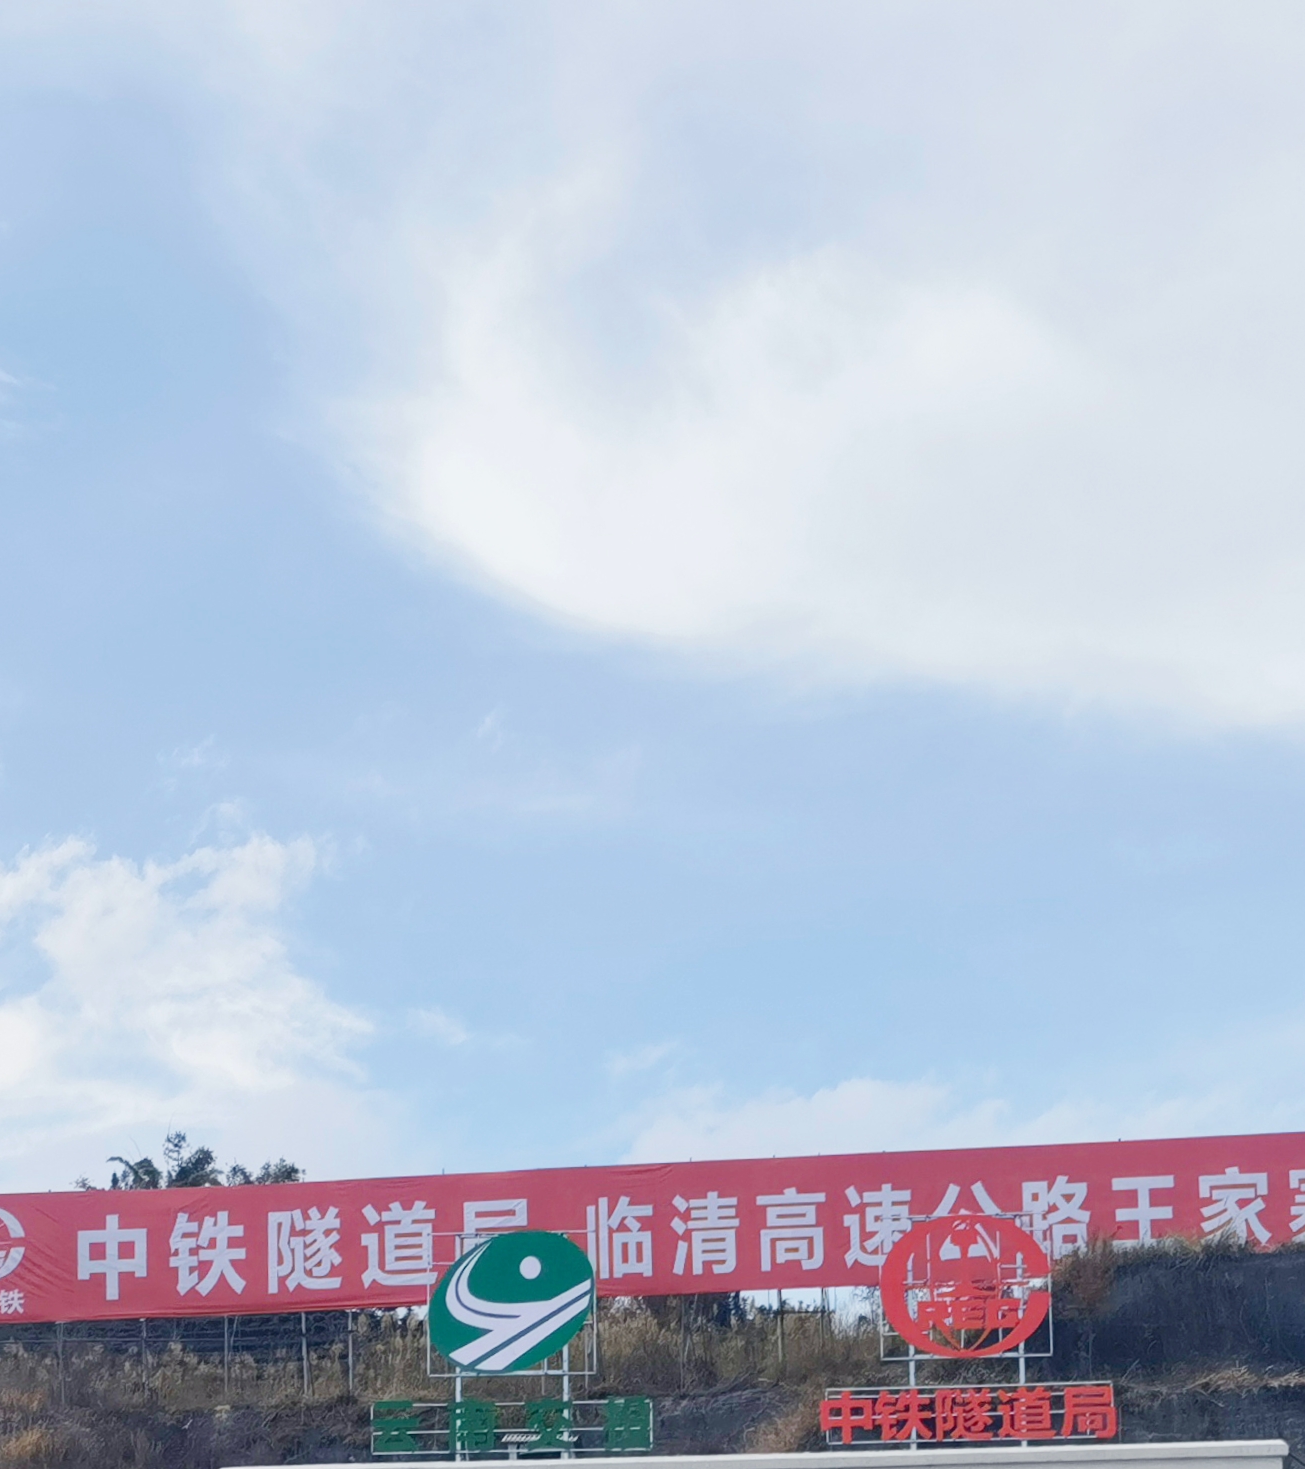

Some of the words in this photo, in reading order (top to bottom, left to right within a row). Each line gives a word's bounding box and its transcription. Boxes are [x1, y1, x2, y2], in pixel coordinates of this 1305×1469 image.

[820, 1386, 1116, 1444] 中铁隧道局
